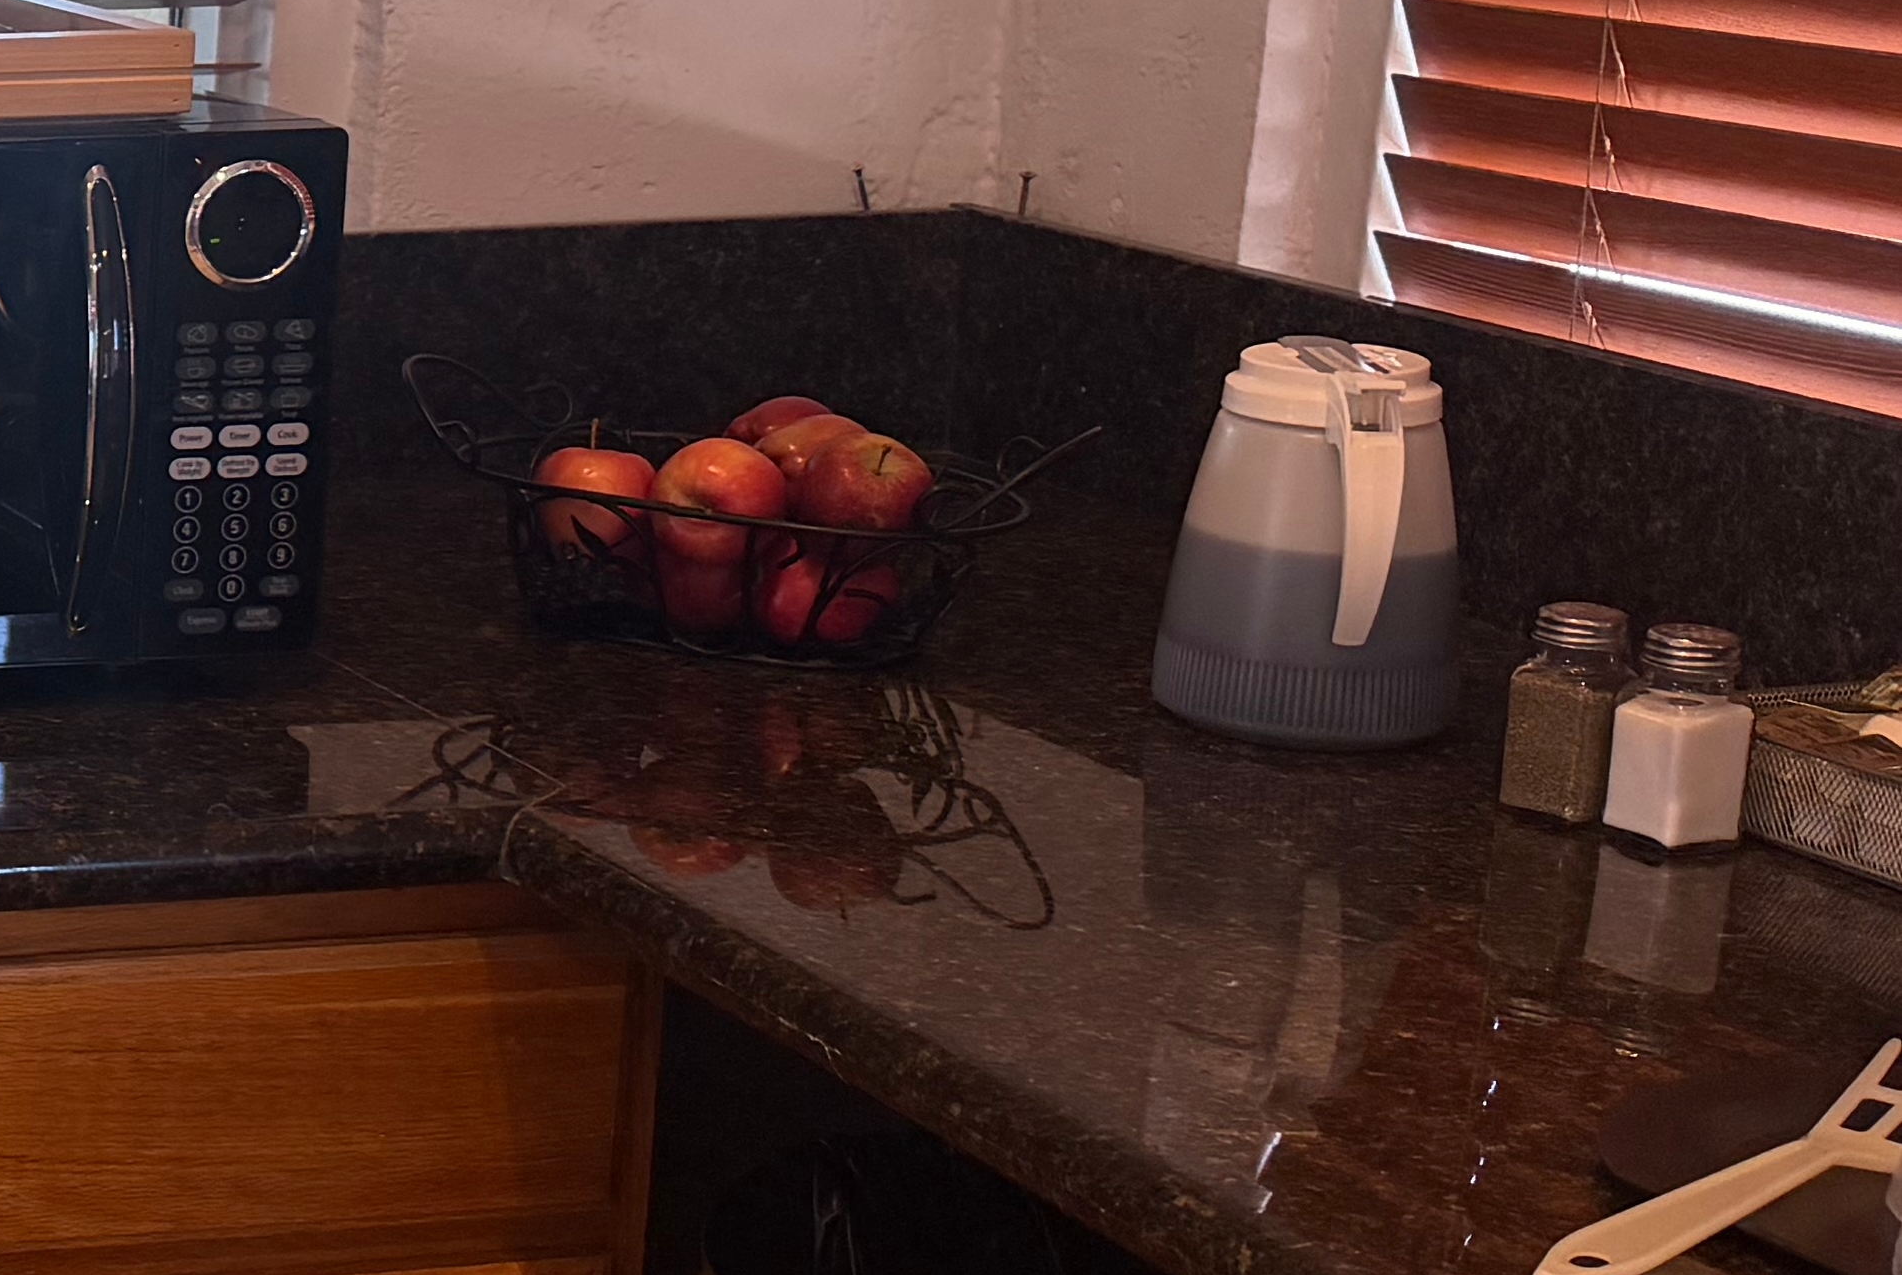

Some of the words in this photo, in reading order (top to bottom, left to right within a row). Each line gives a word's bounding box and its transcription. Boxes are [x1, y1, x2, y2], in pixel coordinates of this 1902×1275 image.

[184, 492, 191, 506] 1
[231, 490, 242, 504] 2
[279, 488, 289, 502] 3
[181, 523, 191, 536] 4
[230, 520, 240, 534] 5
[278, 518, 288, 532] 6
[180, 553, 190, 567] 7
[228, 551, 238, 565] 8
[276, 549, 286, 563] 9
[226, 581, 236, 594] 0
